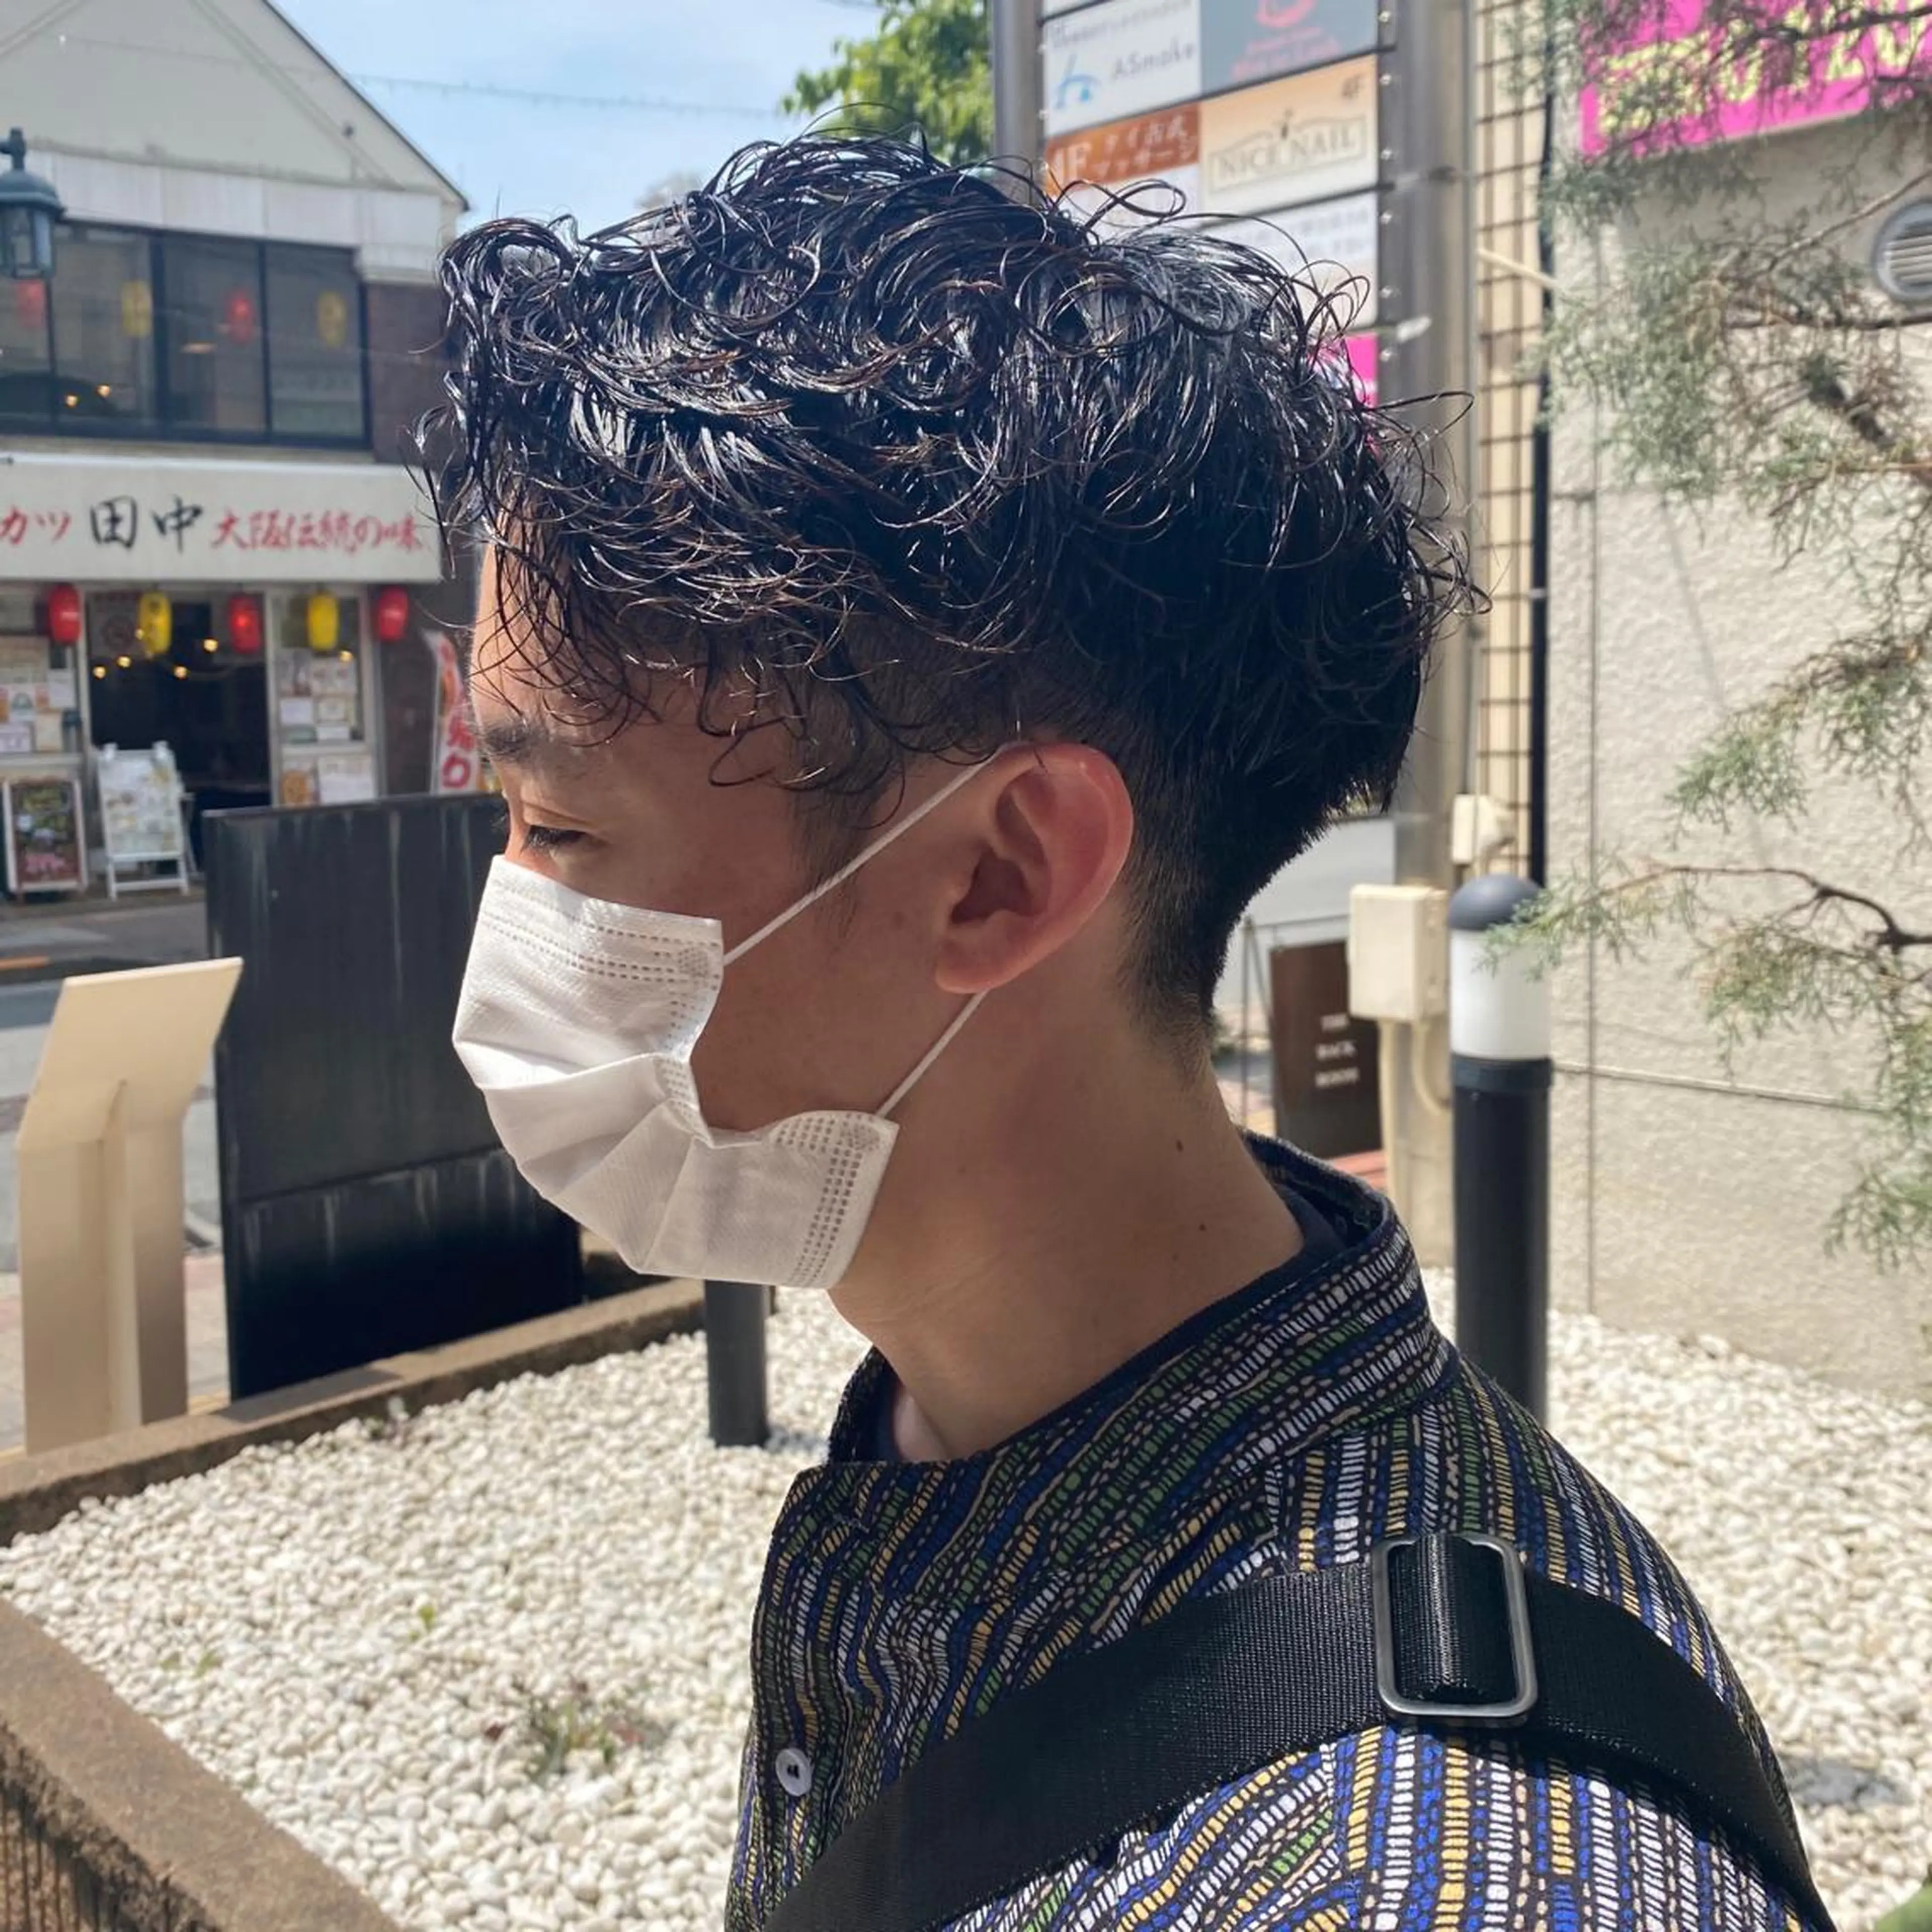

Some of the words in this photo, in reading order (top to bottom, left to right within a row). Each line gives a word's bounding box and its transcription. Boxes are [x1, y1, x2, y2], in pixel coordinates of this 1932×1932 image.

[1290, 124, 1357, 167] NAIL
[0, 504, 71, 545] カツ
[89, 494, 204, 555] 田中
[211, 507, 422, 556] 大阪伝統の味
